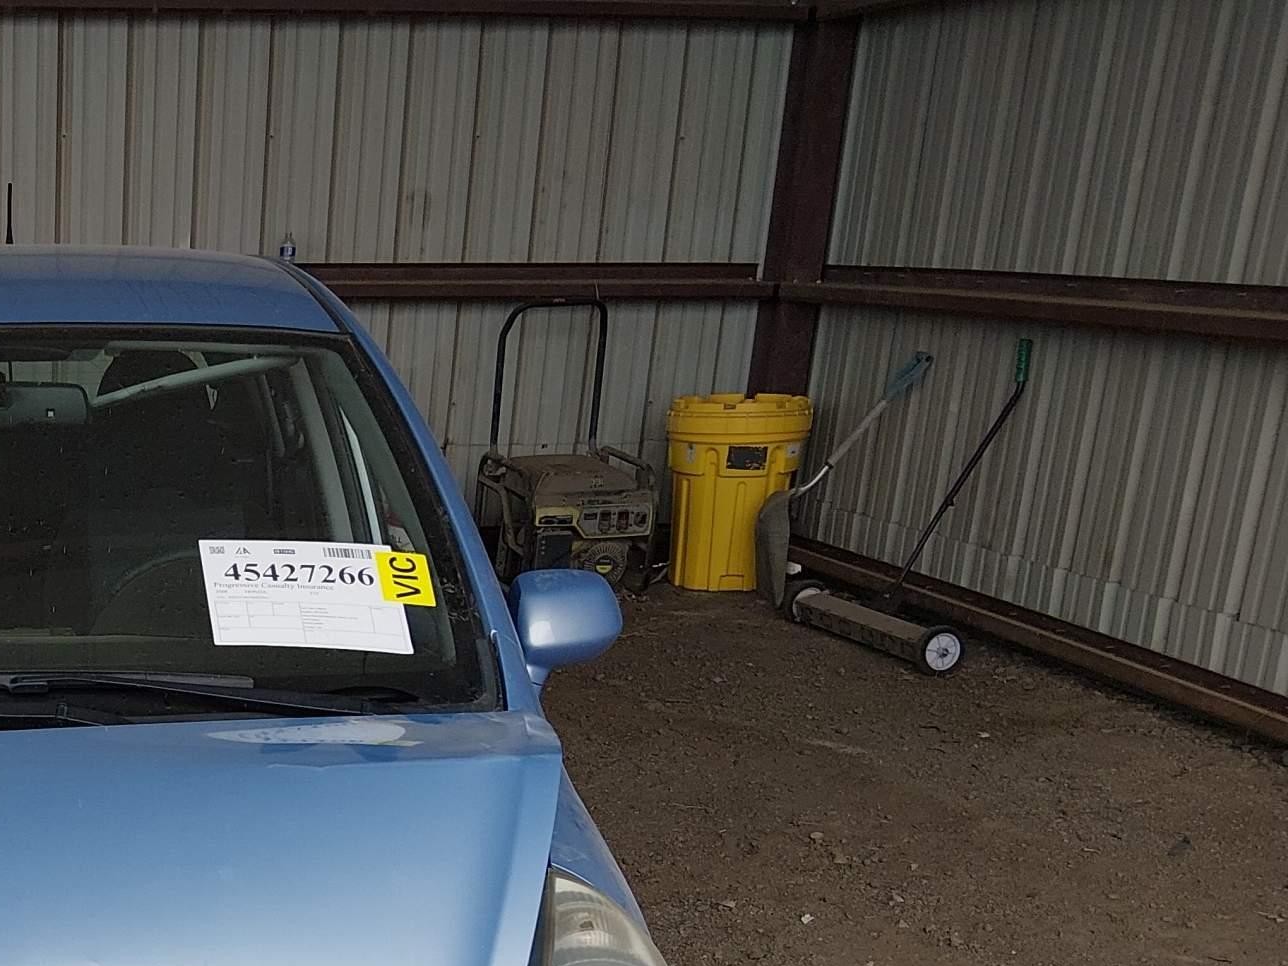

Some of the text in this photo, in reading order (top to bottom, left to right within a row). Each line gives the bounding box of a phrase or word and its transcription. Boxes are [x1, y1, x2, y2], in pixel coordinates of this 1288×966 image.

[224, 563, 375, 586] 45427266
[389, 557, 421, 599] VIC
[261, 583, 294, 593] Casualty
